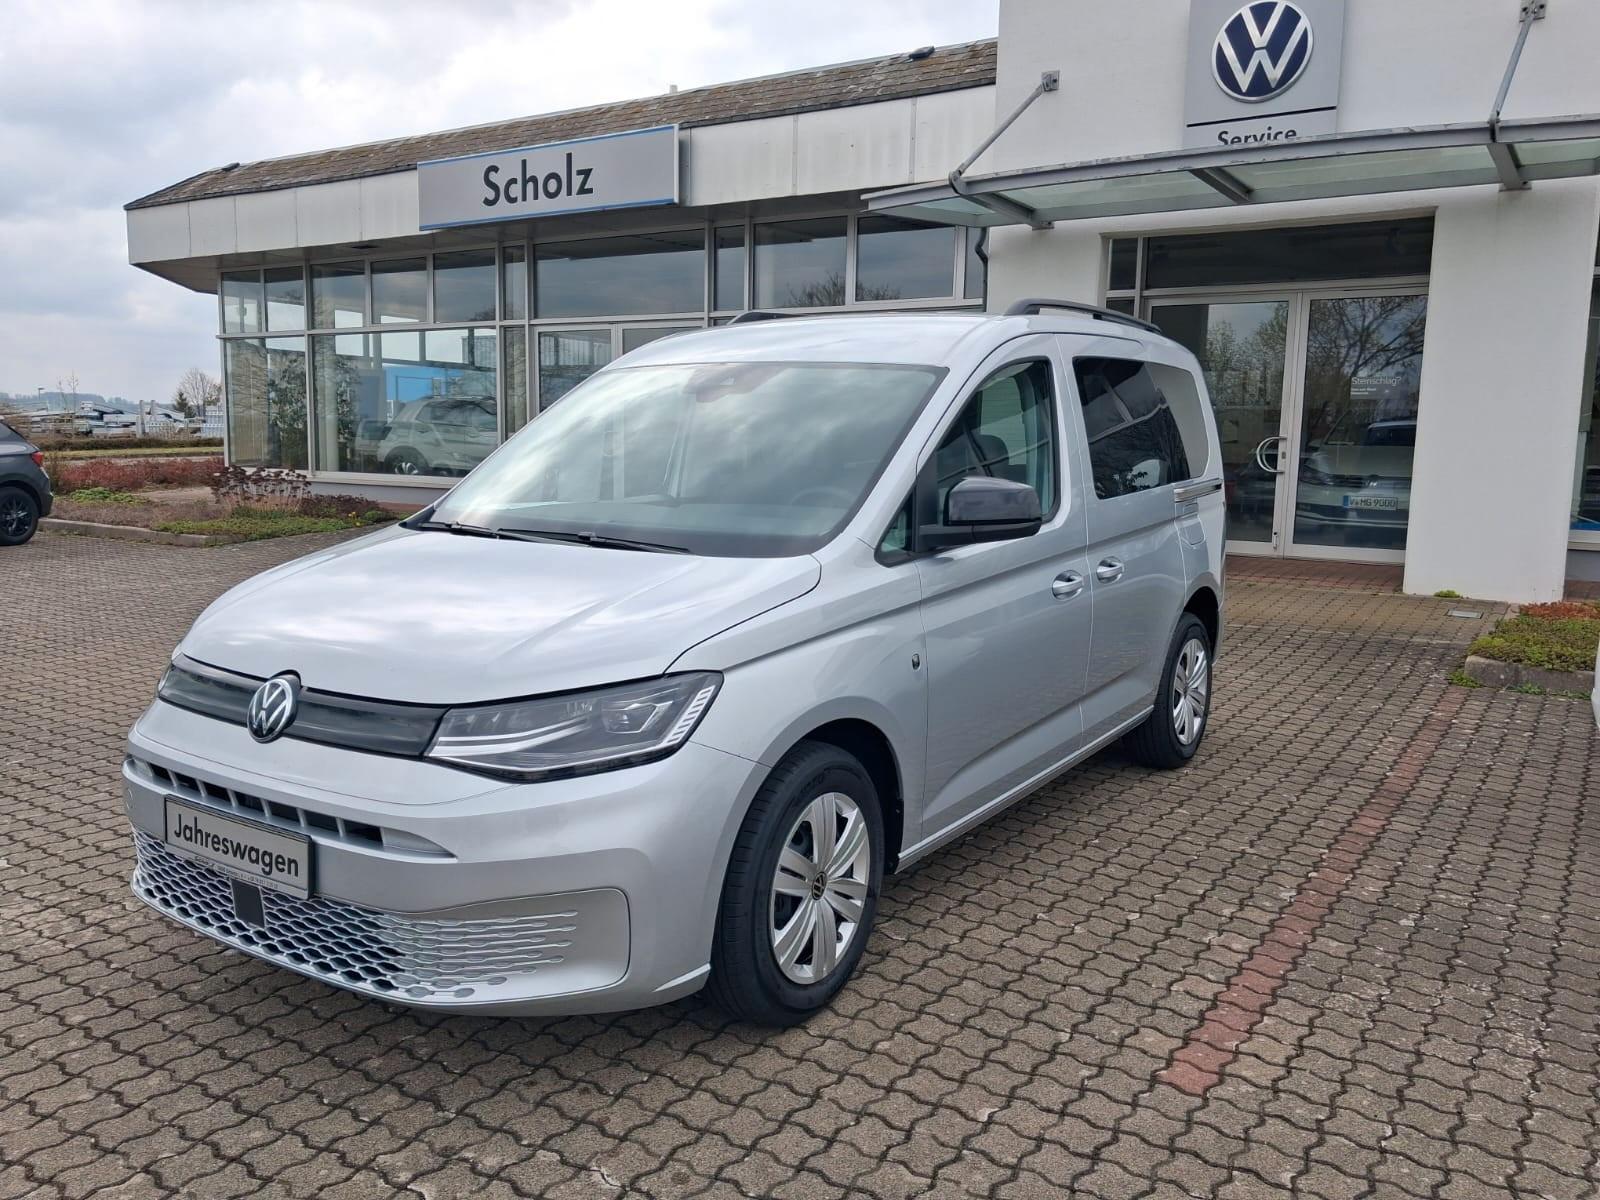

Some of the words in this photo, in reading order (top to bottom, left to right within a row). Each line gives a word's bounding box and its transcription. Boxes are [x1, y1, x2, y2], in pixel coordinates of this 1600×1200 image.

[1214, 1, 1312, 99] VW
[483, 152, 594, 207] Scholz
[1351, 376, 1402, 387] Steinschlag?
[248, 680, 292, 739] VW
[174, 813, 299, 877] Jahreswagen
